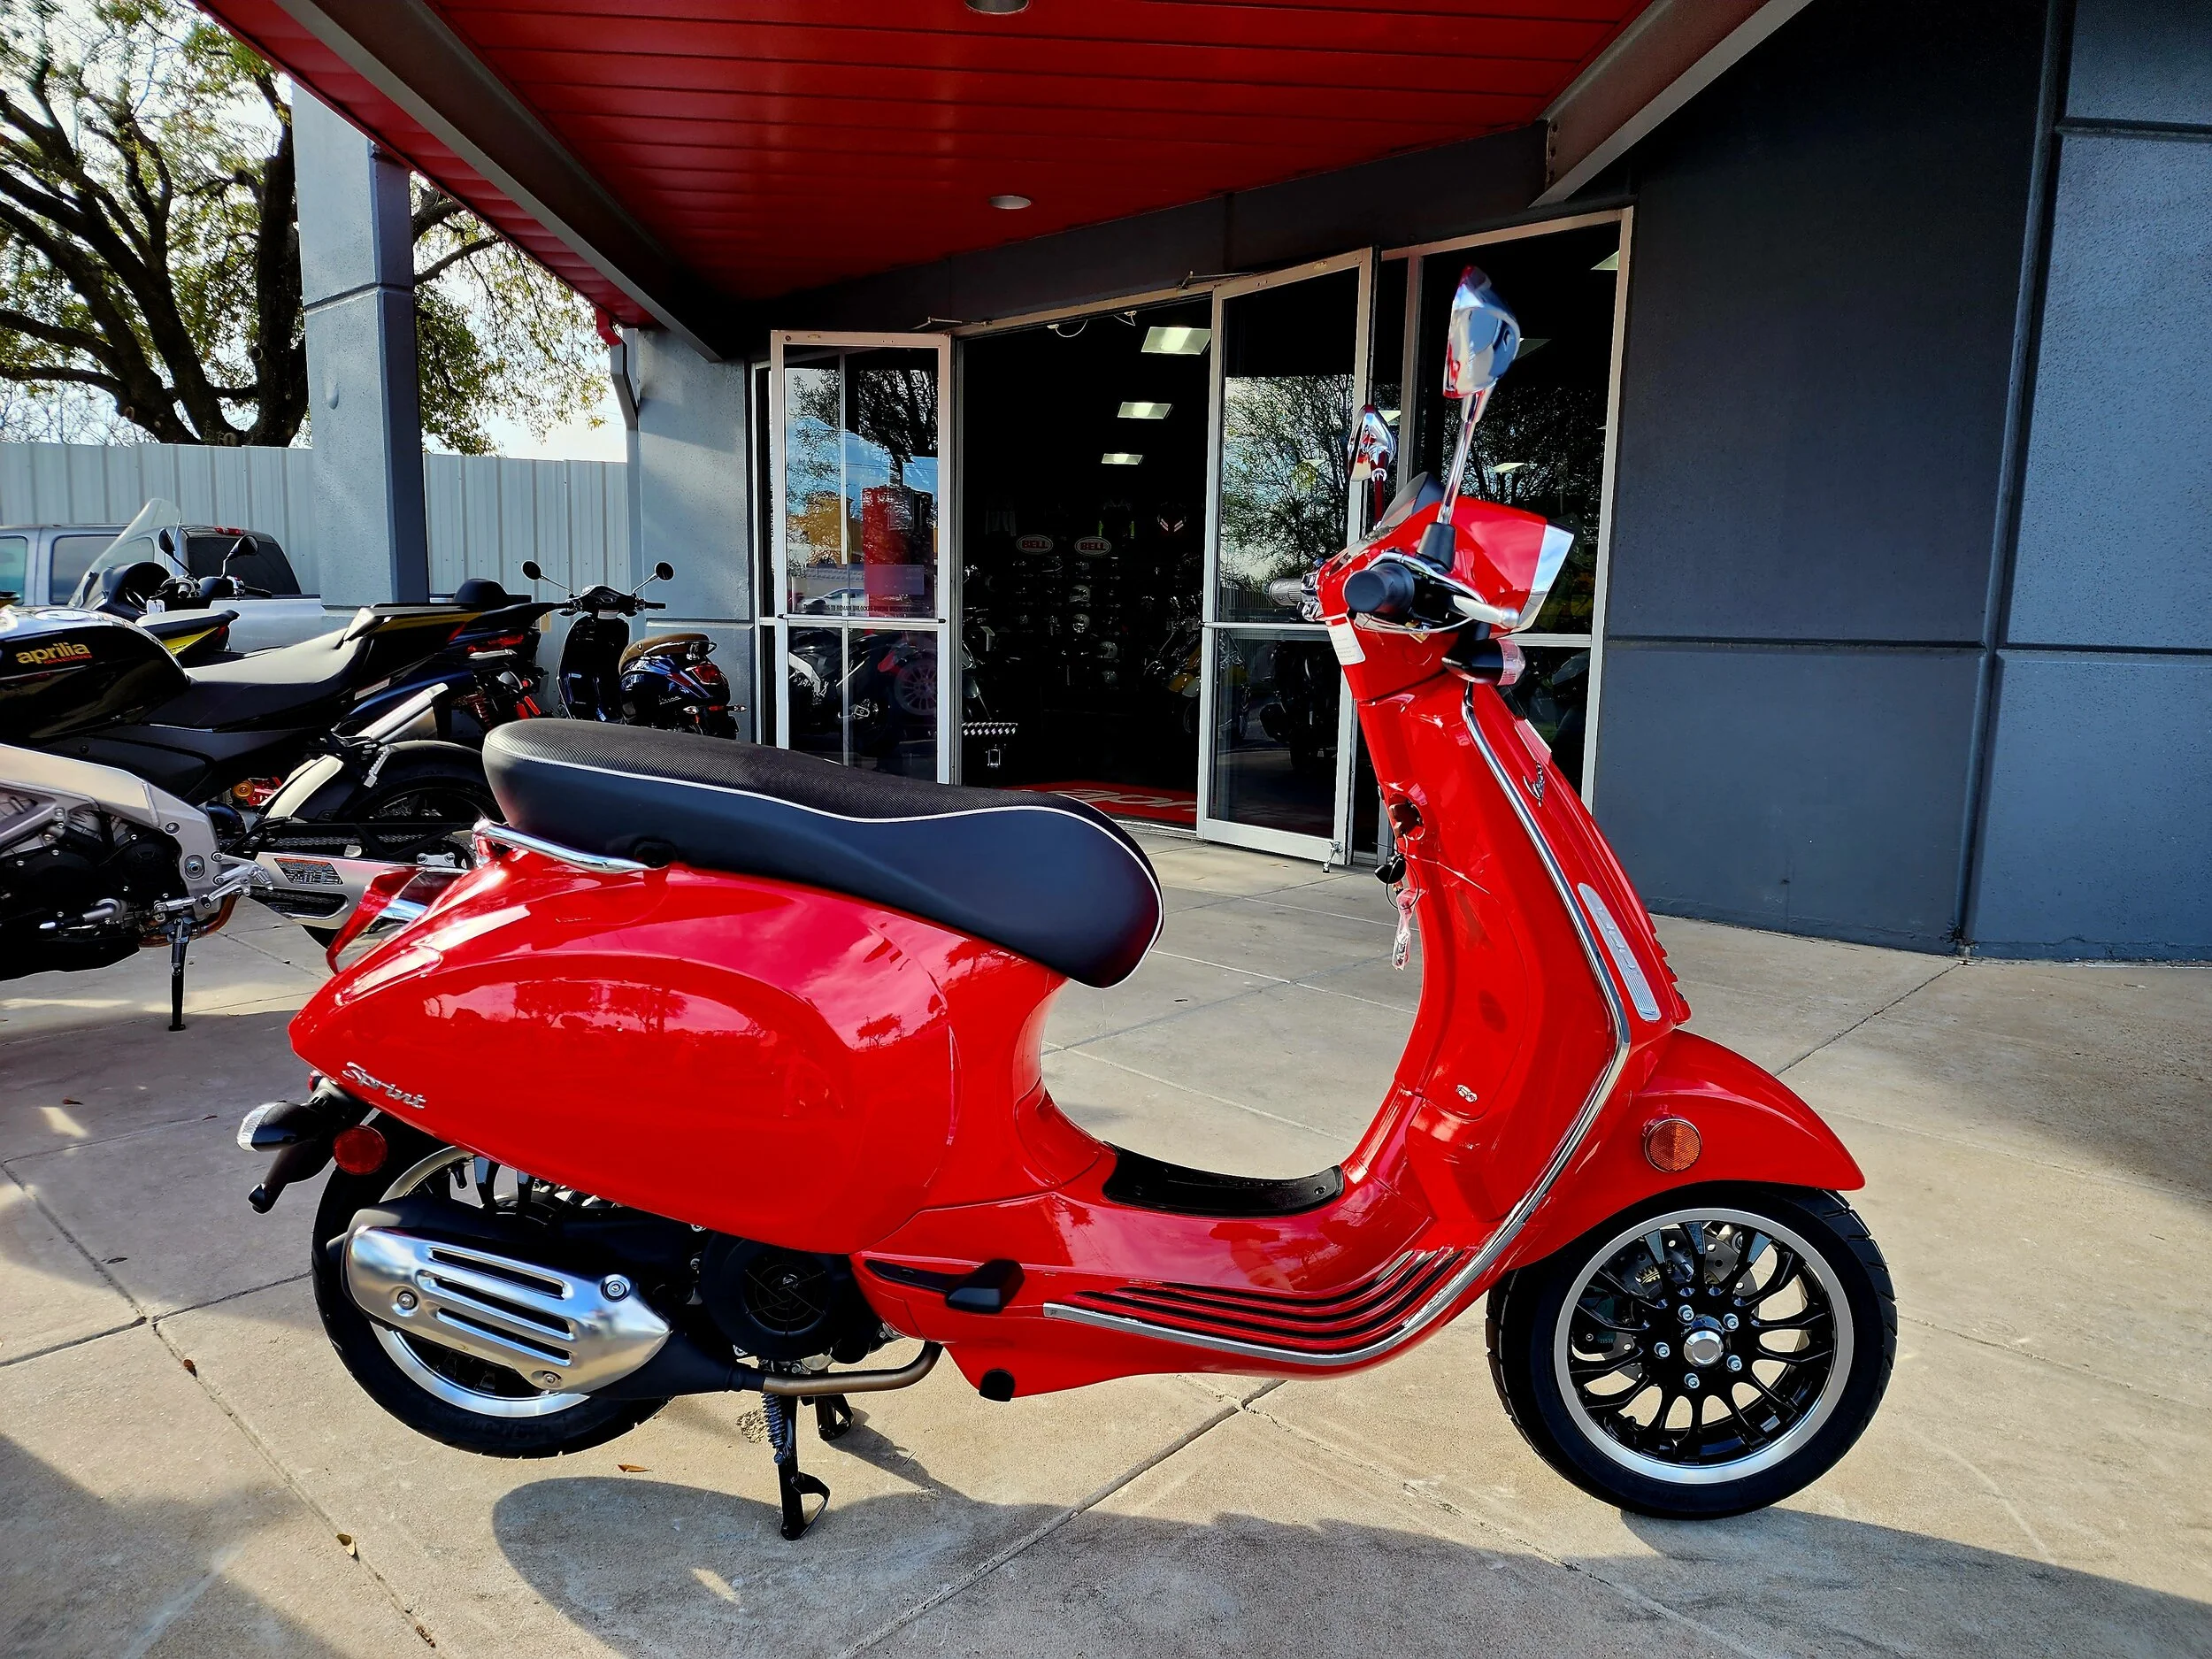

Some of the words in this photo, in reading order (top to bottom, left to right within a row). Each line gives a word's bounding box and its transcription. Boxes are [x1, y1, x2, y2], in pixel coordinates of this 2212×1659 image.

[1021, 540, 1048, 549] BELL
[1079, 541, 1107, 551] BELL
[16, 642, 90, 664] aprilia
[342, 1062, 426, 1109] Sprint
